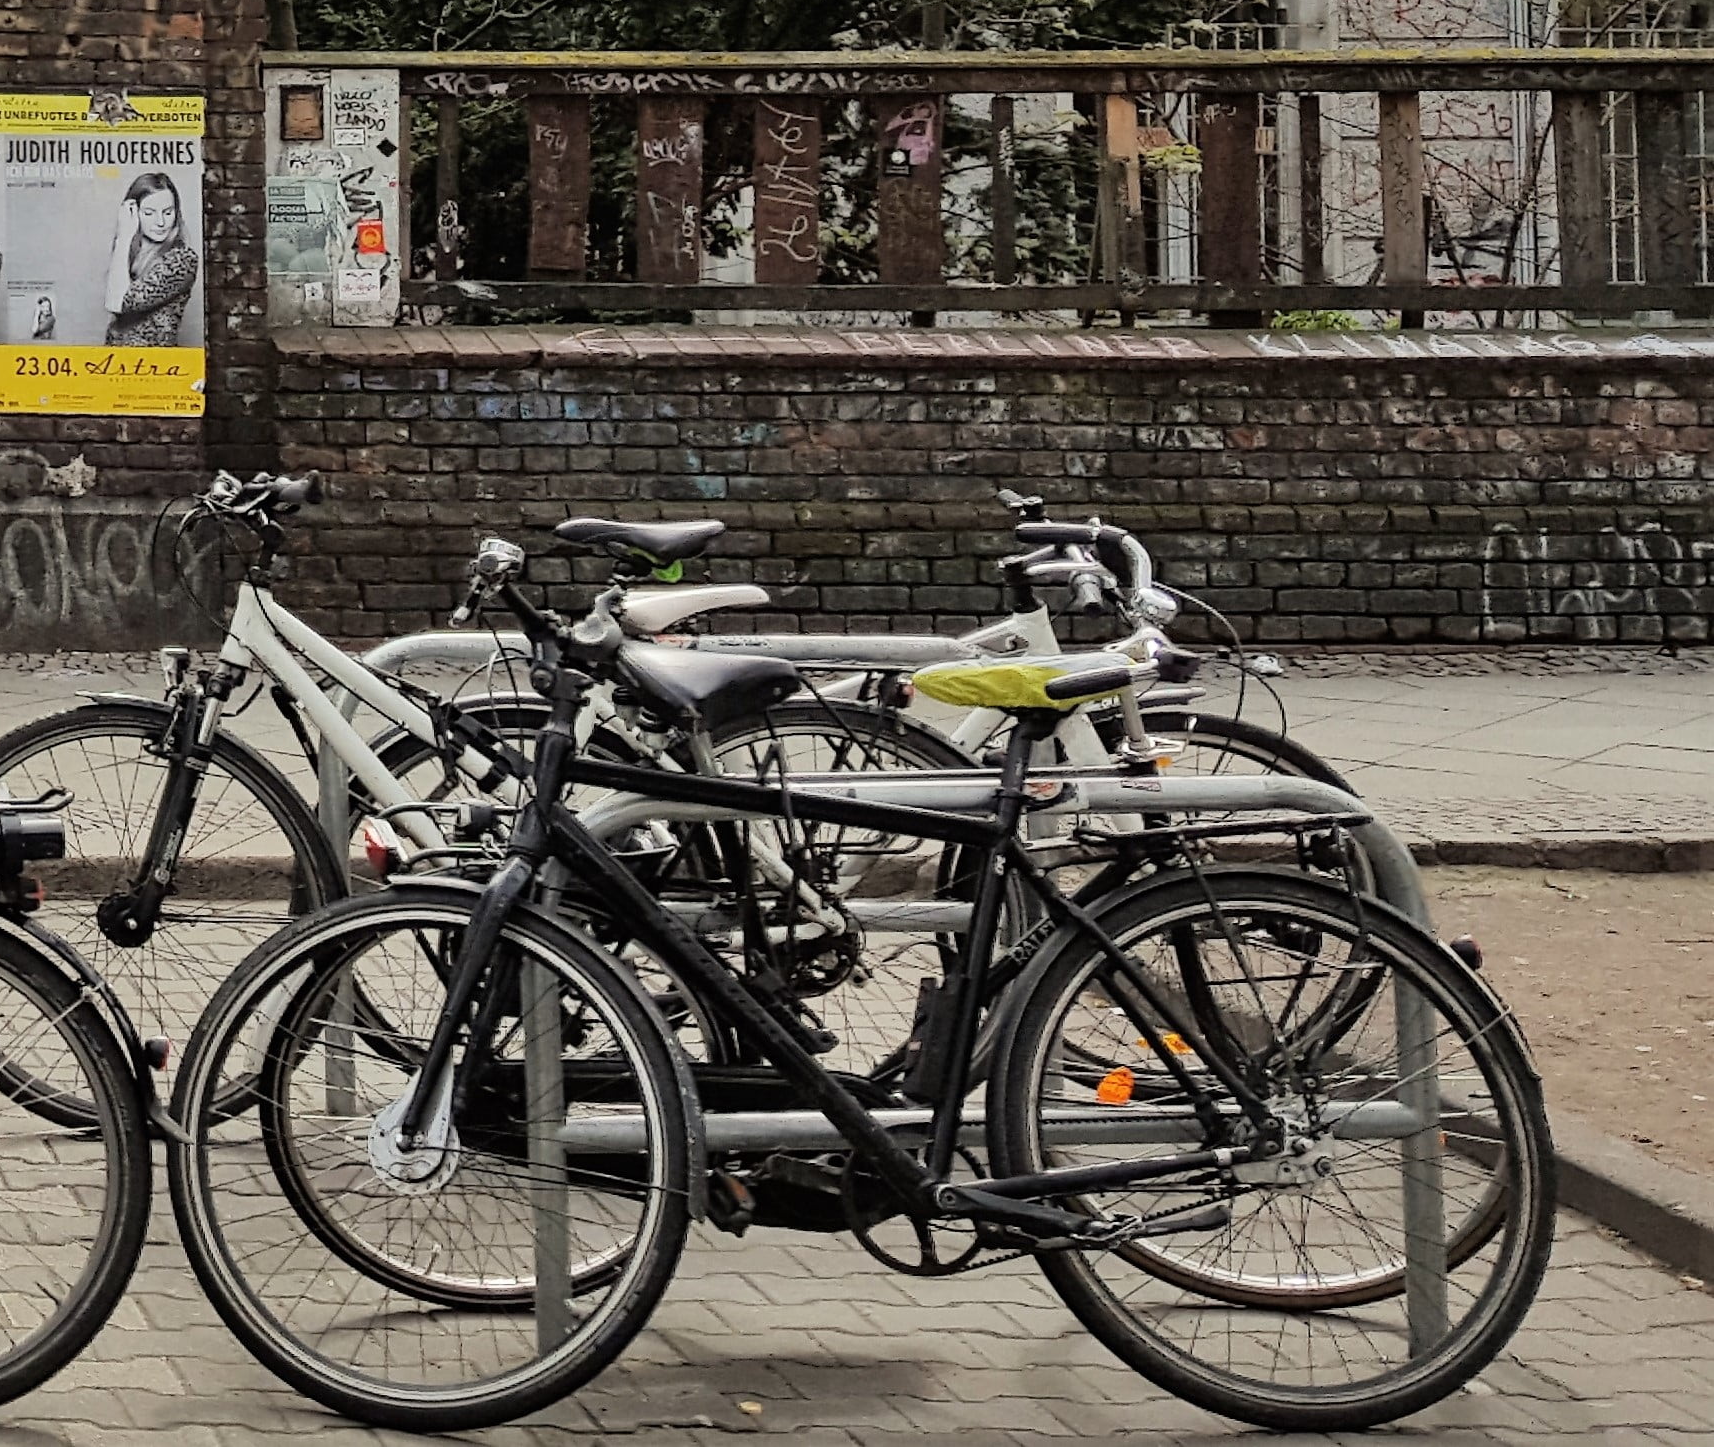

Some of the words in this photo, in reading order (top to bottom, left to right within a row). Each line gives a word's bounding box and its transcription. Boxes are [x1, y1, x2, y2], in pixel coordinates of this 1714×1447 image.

[4, 111, 78, 122] UNBEFUGTES
[144, 112, 201, 124] VERBOTEN
[6, 140, 70, 165] JUDITH
[80, 141, 195, 166] HOLOFERNES
[15, 357, 78, 376] 23.04.
[85, 353, 190, 377] Astra
